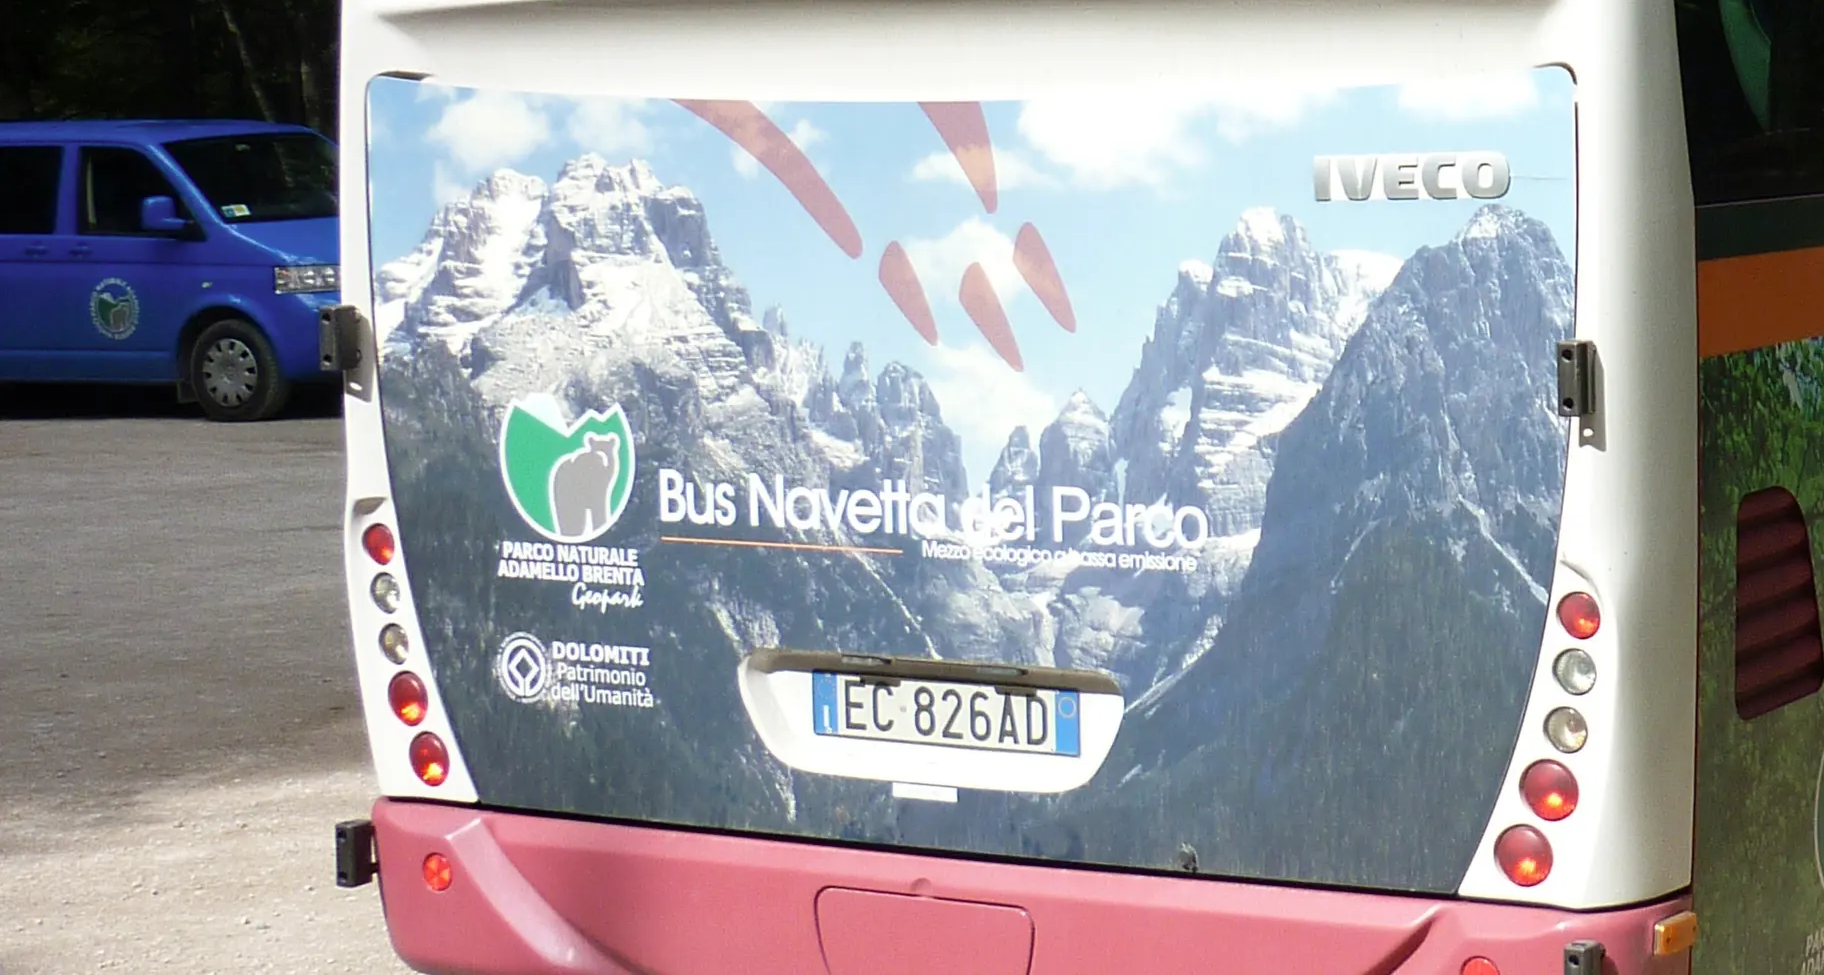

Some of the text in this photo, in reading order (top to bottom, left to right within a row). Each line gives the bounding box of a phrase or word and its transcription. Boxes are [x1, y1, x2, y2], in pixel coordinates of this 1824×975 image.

[1313, 152, 1512, 202] IVECO
[659, 468, 1209, 549] Bus Navetta del Parco
[502, 540, 639, 567] PARCO NATURALE
[921, 539, 970, 561] Mezzo
[972, 544, 1053, 567] ecologico
[1067, 547, 1117, 567] bassa
[1118, 550, 1199, 573] emissione
[497, 559, 646, 587] ADAMELLO BRENTA
[571, 580, 645, 615] Geopark
[551, 641, 650, 667] DOLOMITI
[556, 661, 647, 687] Patrimonio
[550, 681, 655, 709] dell'Umanità
[844, 679, 1049, 746] EC 826AD
